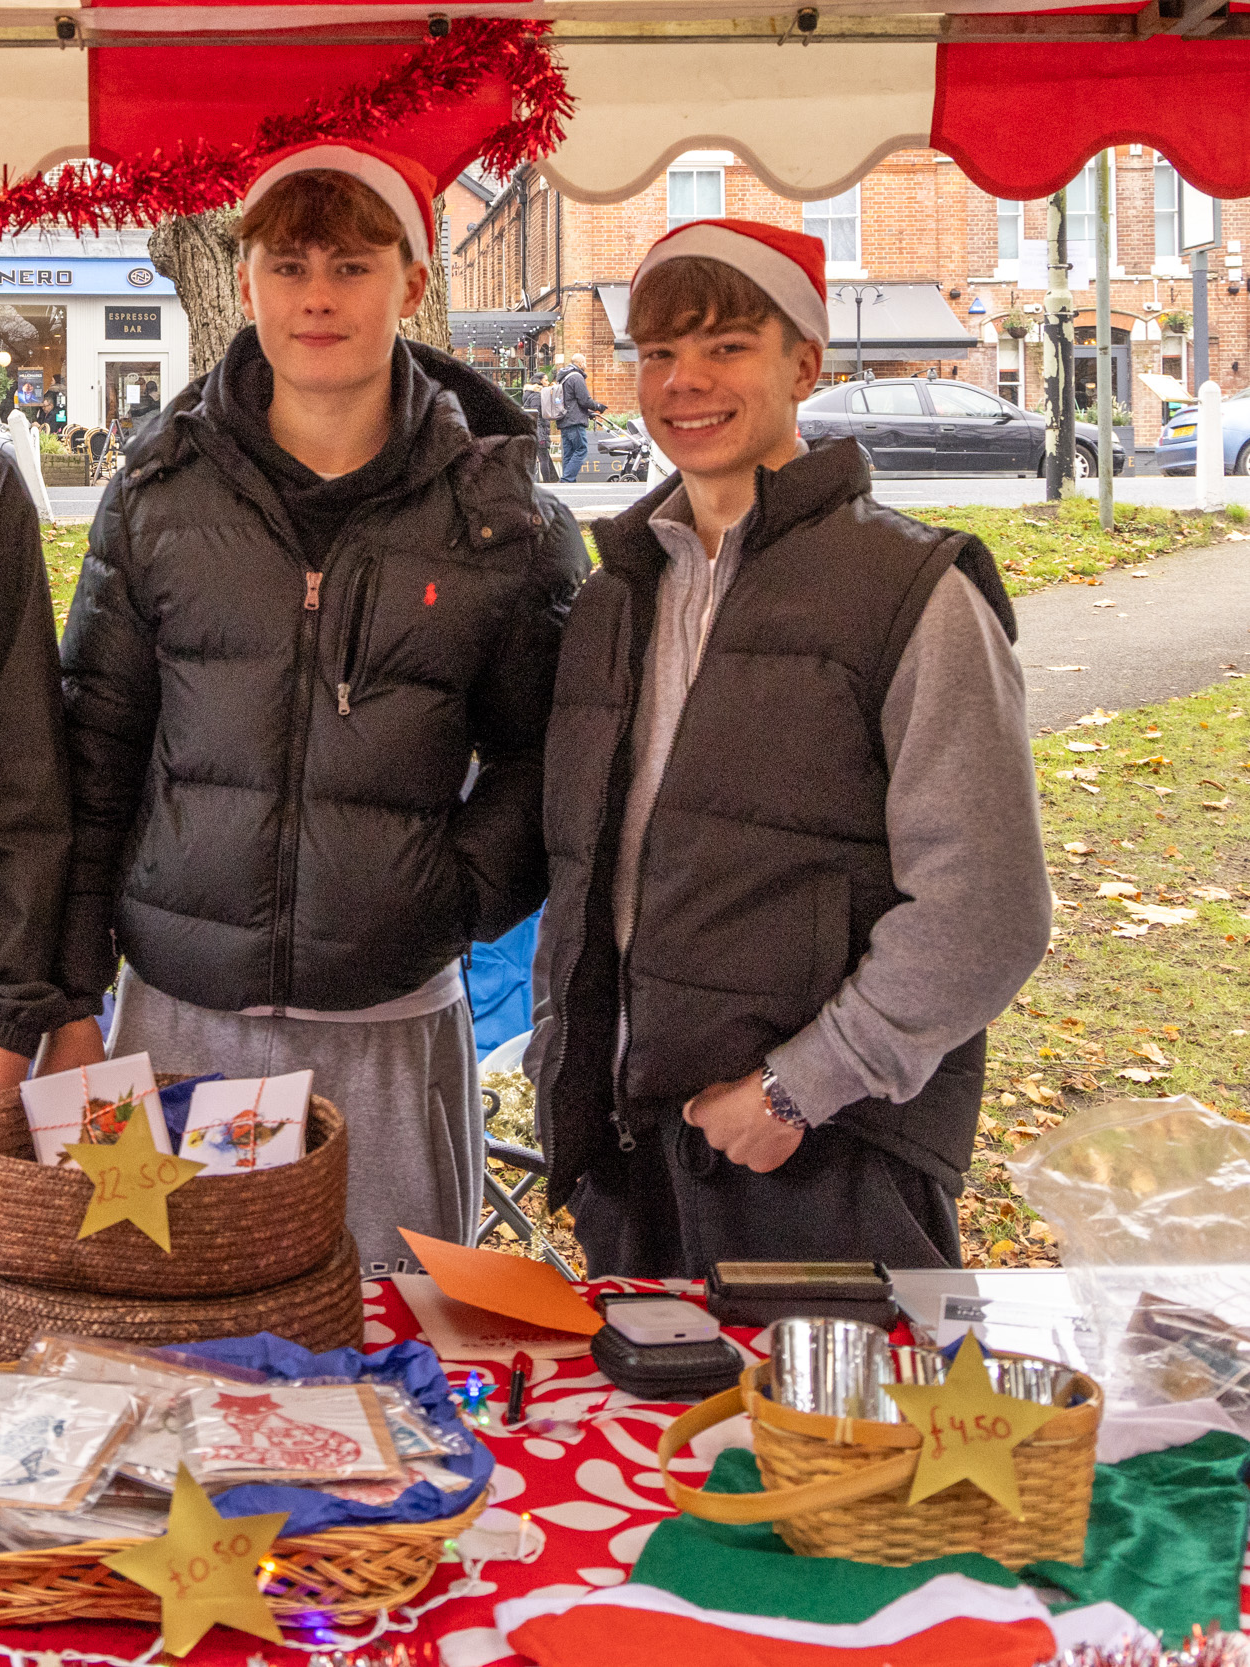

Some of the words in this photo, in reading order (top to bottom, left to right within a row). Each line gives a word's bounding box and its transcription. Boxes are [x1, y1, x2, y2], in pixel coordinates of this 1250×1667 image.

[108, 312, 158, 321] ESPRESSO
[123, 325, 143, 334] BAR
[930, 1405, 1012, 1460] £4.50
[167, 1534, 252, 1600] £0.50
